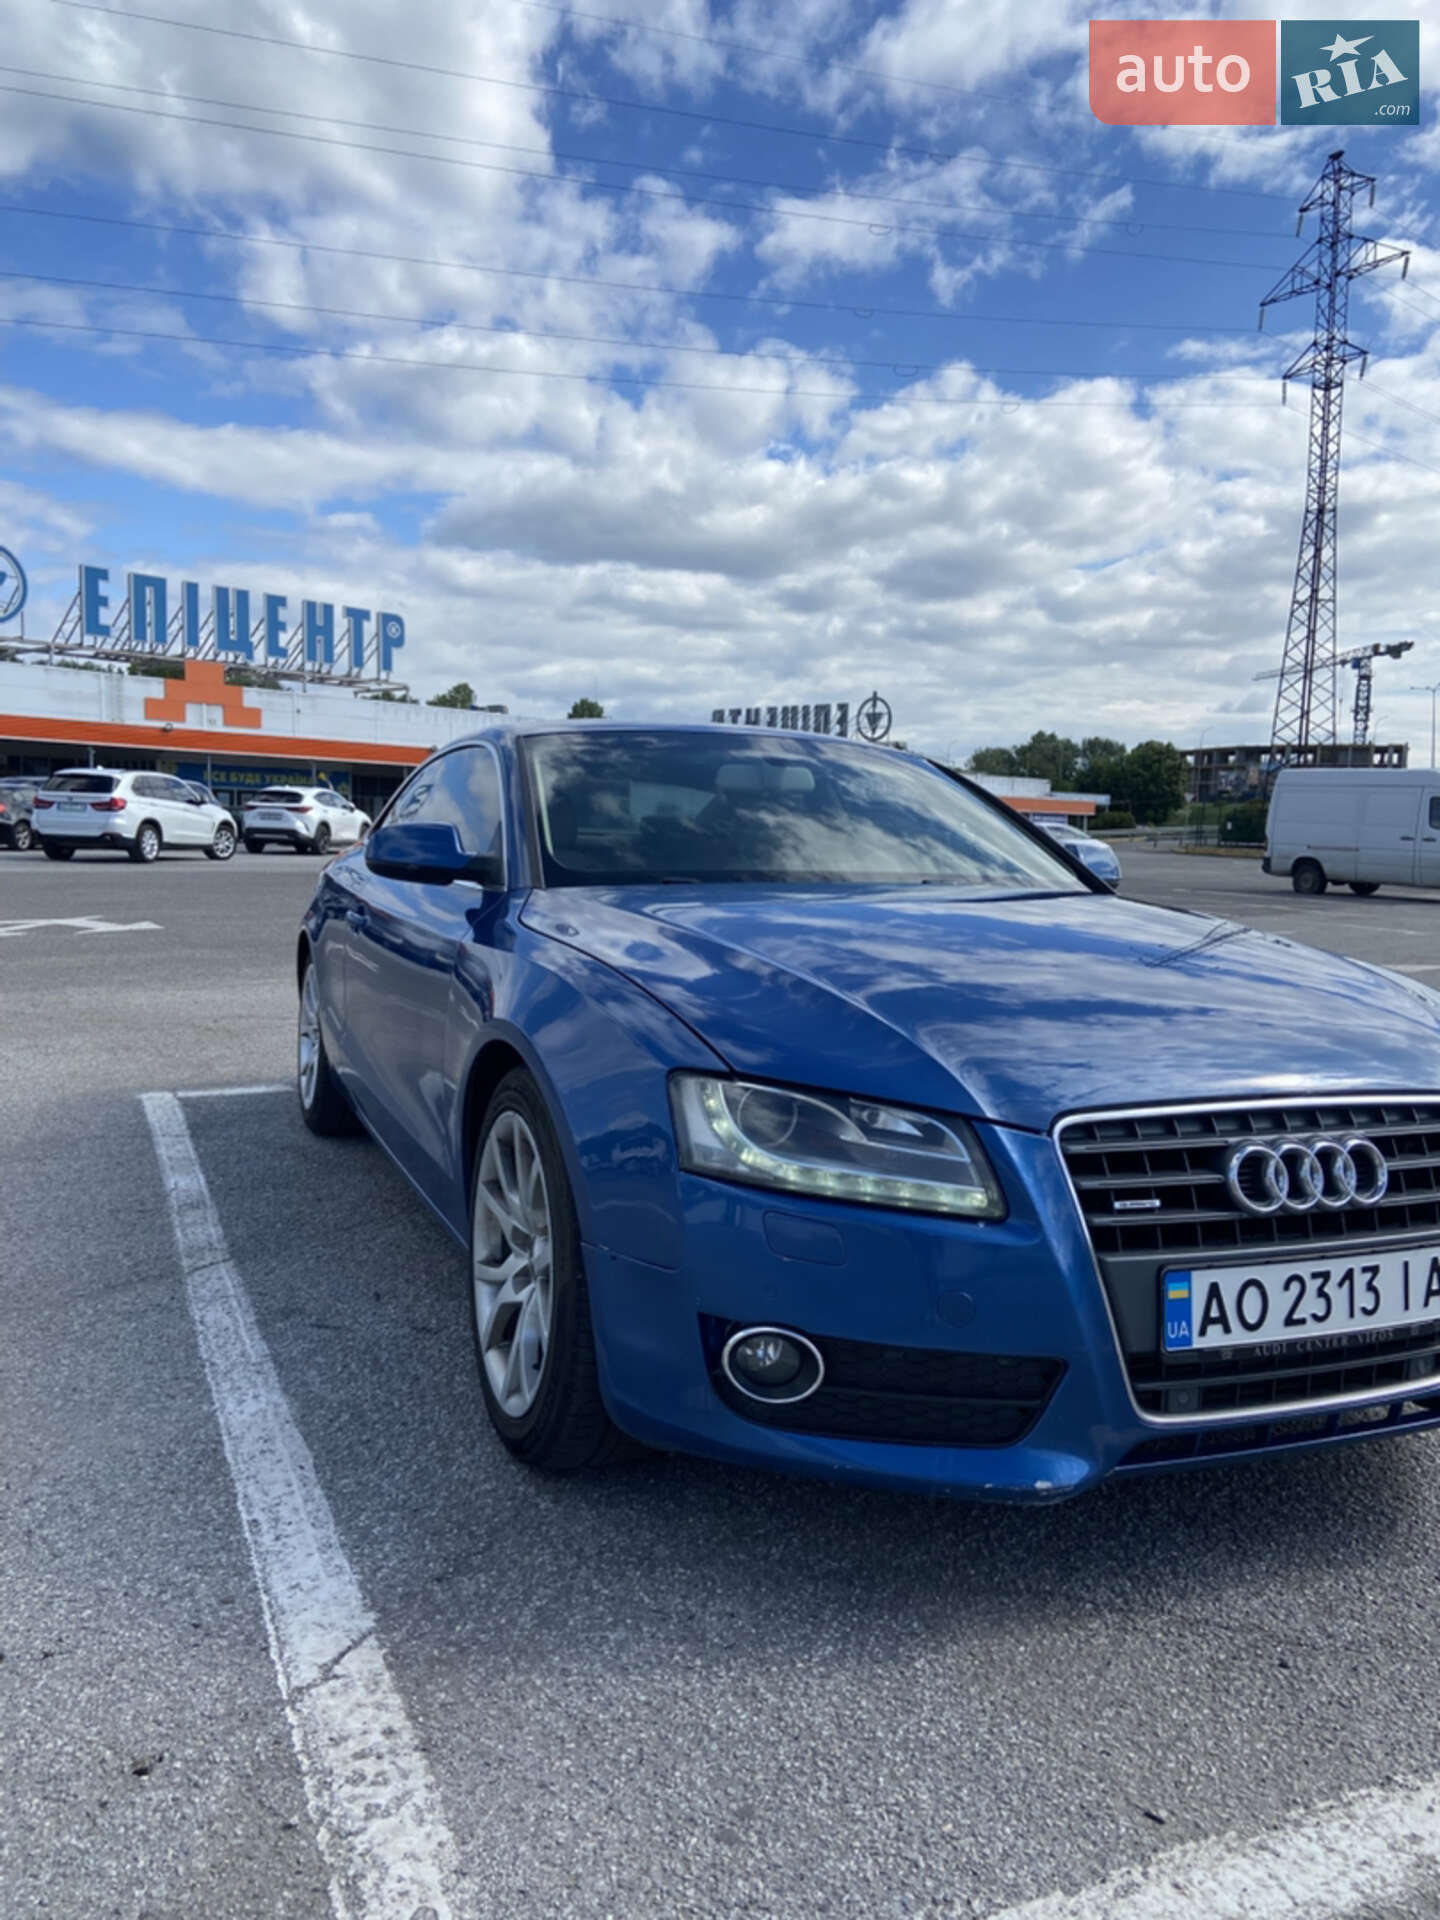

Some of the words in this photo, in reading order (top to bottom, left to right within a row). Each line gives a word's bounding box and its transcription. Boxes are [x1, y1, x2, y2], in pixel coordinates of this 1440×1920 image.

[80, 564, 405, 671] ЕПІЦЕНТР
[1198, 1278, 1269, 1337] AO
[1283, 1264, 1381, 1328] 2313
[1167, 1321, 1189, 1339] UA
[1253, 1341, 1287, 1357] AUDI
